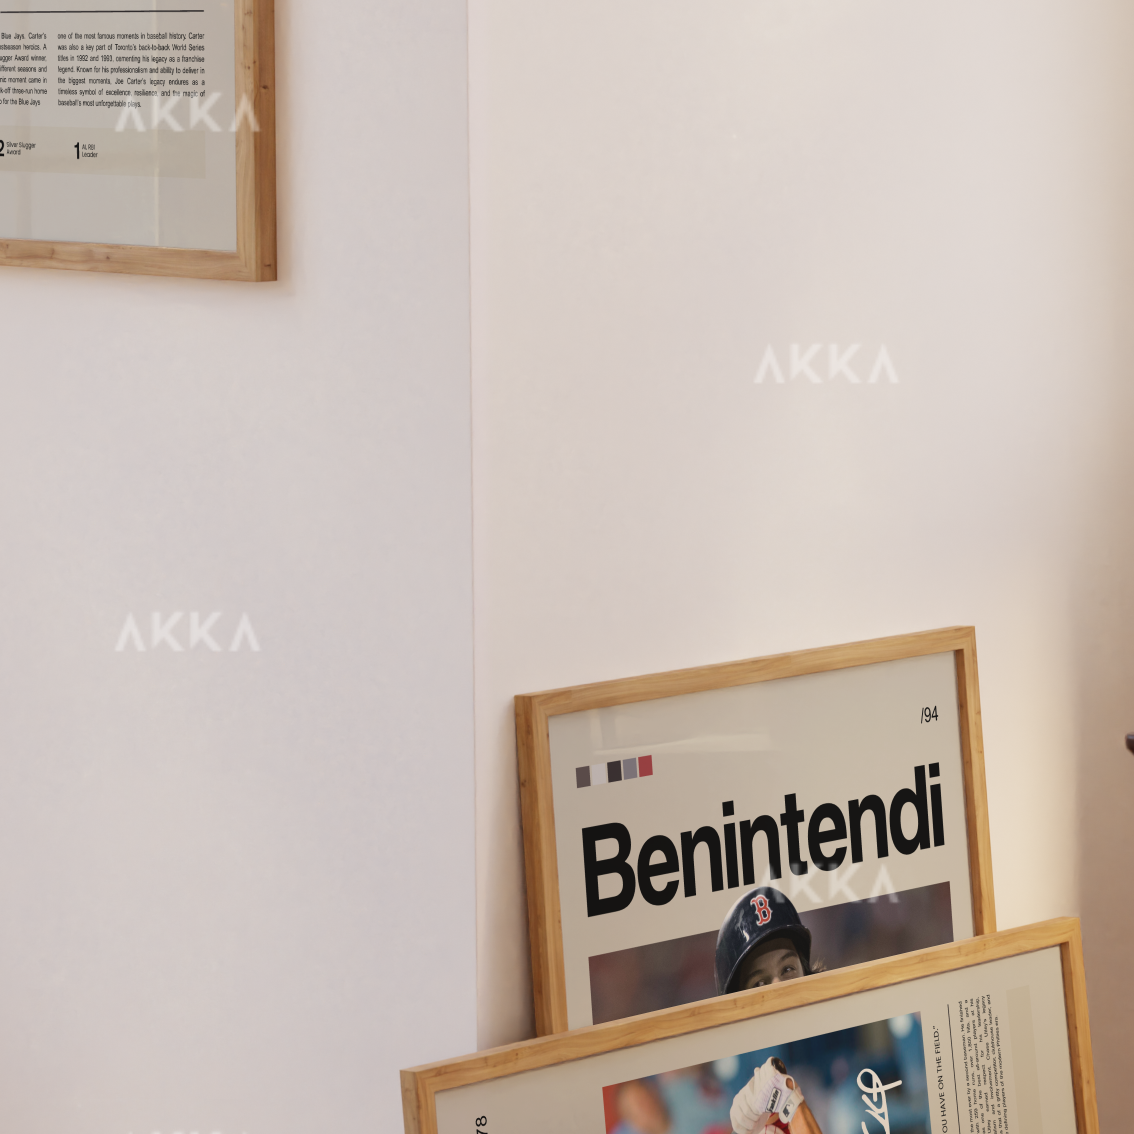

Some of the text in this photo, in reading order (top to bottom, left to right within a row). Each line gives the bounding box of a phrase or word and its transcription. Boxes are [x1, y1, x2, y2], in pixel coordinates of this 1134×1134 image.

[86, 44, 94, 52] key
[96, 44, 106, 52] part
[116, 55, 141, 63] cementing
[151, 55, 167, 64] legacy
[58, 66, 74, 74] legend.
[160, 67, 174, 75] ability
[68, 77, 86, 85] biggest
[149, 78, 165, 87] legacy
[79, 88, 96, 96] symbol
[95, 100, 126, 108] unforgettable
[19, 142, 36, 150] Slugger
[74, 142, 80, 159] 1
[920, 706, 939, 725] /94
[582, 762, 946, 918] Benintendi
[938, 1075, 944, 1090] ON
